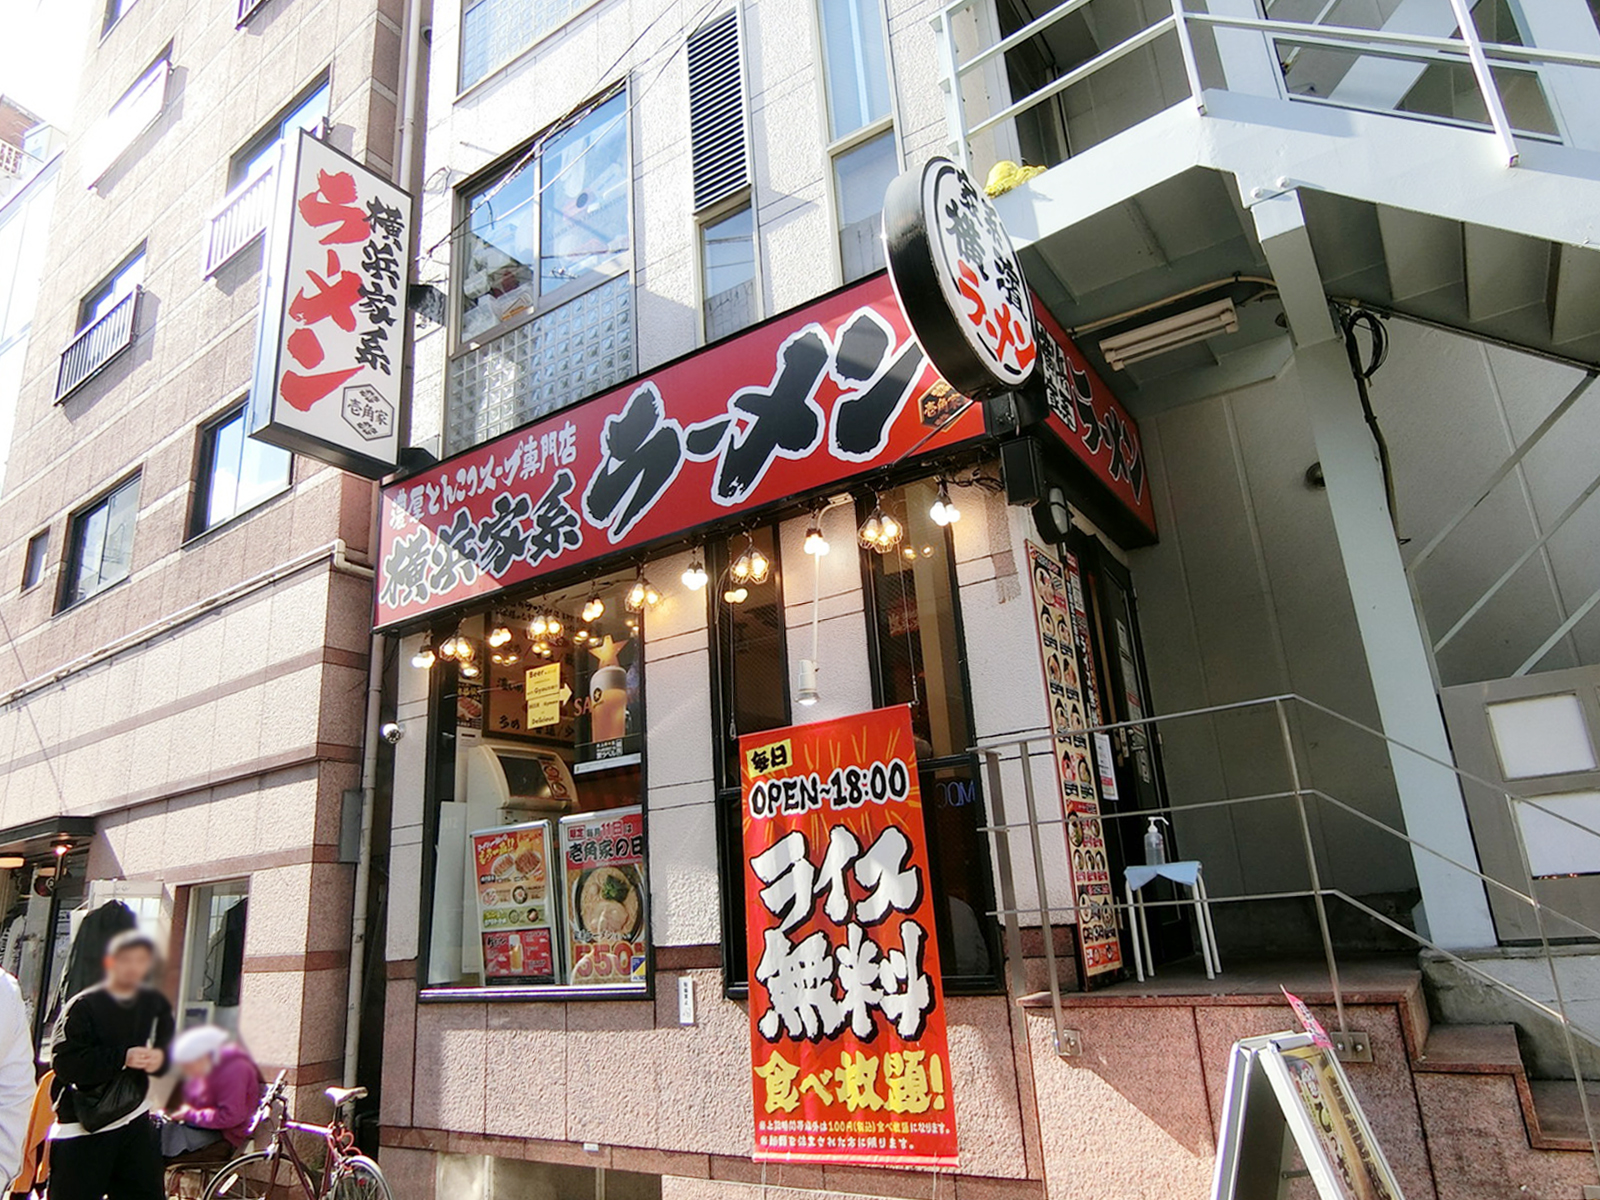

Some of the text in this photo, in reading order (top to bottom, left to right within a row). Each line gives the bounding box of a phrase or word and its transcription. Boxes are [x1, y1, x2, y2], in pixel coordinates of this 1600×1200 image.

[278, 168, 371, 412] ラーメン
[355, 195, 405, 376] 横浜家系
[957, 259, 1038, 370] ラーメン
[347, 397, 389, 426] 壱角家
[582, 306, 928, 543] ラーメン
[1066, 357, 1144, 505] ラーメン
[389, 420, 577, 530] 濃厚とんこつスープ専門店
[380, 469, 583, 609] 横浜家系
[751, 745, 787, 772] 毎日
[568, 835, 644, 863] 壱角家の日
[750, 825, 922, 933] ライス
[755, 919, 936, 1043] 無料
[754, 1050, 945, 1114] 食べ放題!
